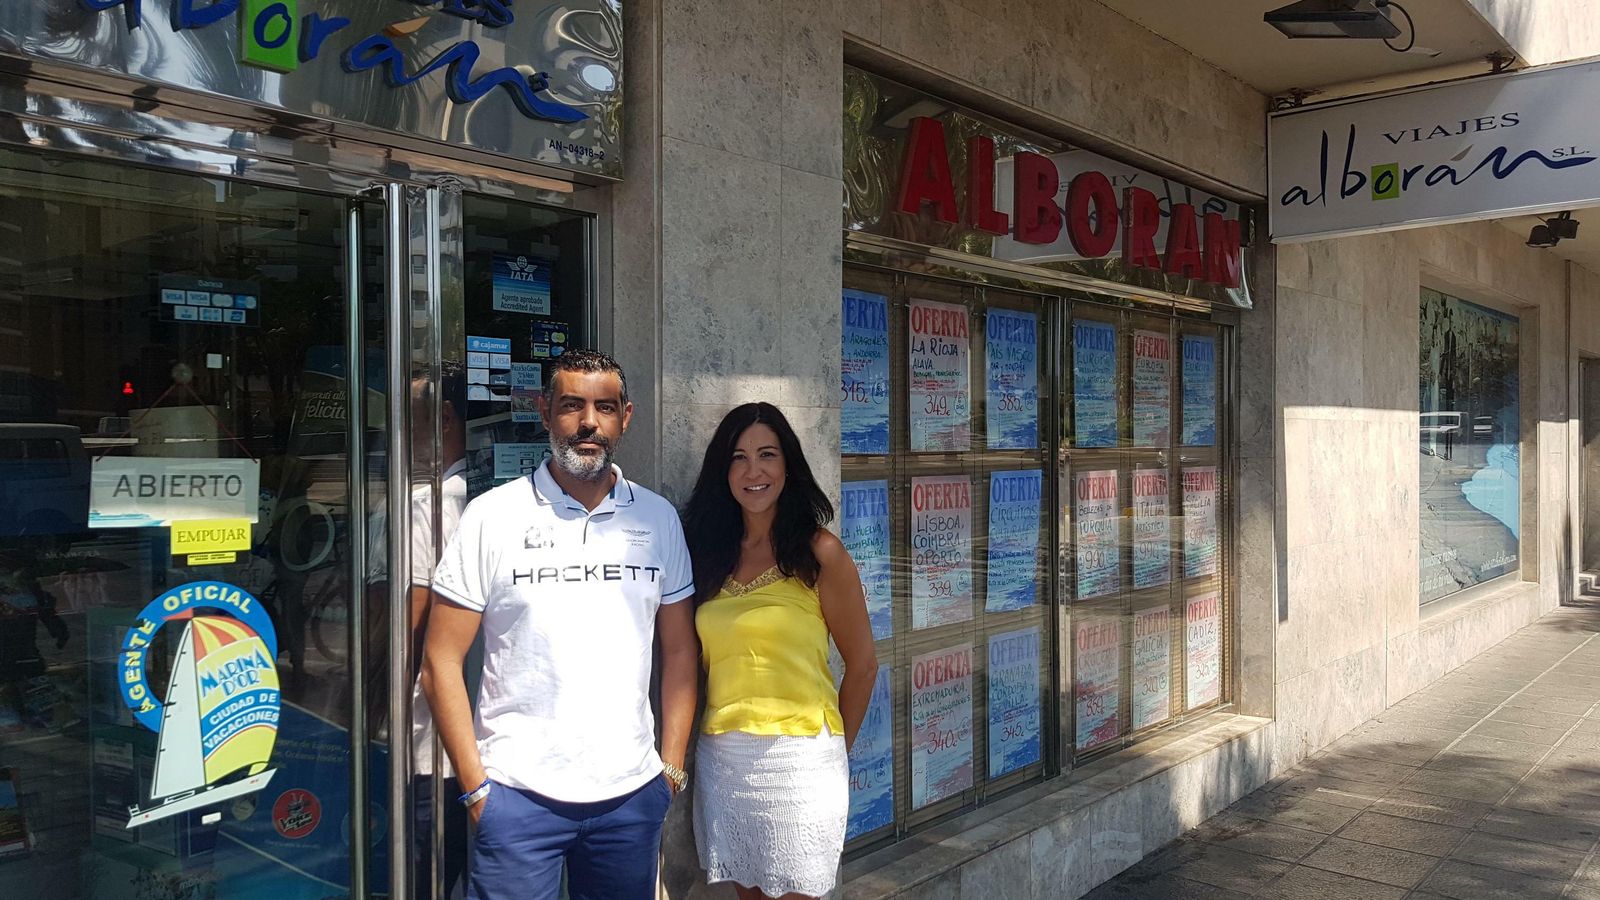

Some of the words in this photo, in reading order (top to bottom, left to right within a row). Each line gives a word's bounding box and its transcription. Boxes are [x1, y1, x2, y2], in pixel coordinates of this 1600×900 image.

[1382, 112, 1521, 144] VIAJES
[1551, 146, 1590, 158] S.L.
[1281, 124, 1598, 208] alborán
[896, 116, 1240, 287] ALBORAN
[510, 271, 534, 282] IATA
[911, 305, 968, 339] OFERTA
[988, 314, 1036, 344] OFERTA
[480, 341, 508, 350] cajamar
[911, 335, 926, 355] LA
[1076, 325, 1114, 351] OFERTA
[1136, 335, 1168, 360] OFERTA
[472, 355, 488, 363] VISA
[494, 356, 509, 364] VISA
[113, 475, 242, 497] ABIERTO
[992, 476, 1040, 503] OFERTA
[1078, 476, 1117, 500] OFERTA
[1134, 474, 1168, 497] OFERTA
[1184, 472, 1214, 492] OFERTA
[913, 482, 970, 512] OFERTA
[177, 528, 246, 544] EMPUJAR
[512, 564, 661, 585] HACKETT
[1136, 610, 1168, 637] OFERTA
[1188, 598, 1217, 623] OFERTA
[125, 616, 156, 713] AGENTE
[163, 585, 251, 613] OFICIAL
[991, 634, 1038, 666] OFERTA
[1079, 623, 1117, 650] OFERTA
[199, 648, 272, 699] MARINA
[222, 668, 260, 697] D'OR
[914, 652, 971, 689] OFERTA
[209, 695, 255, 726] CIUDAD
[259, 693, 277, 703] DE
[203, 710, 280, 750] VACACIONES
